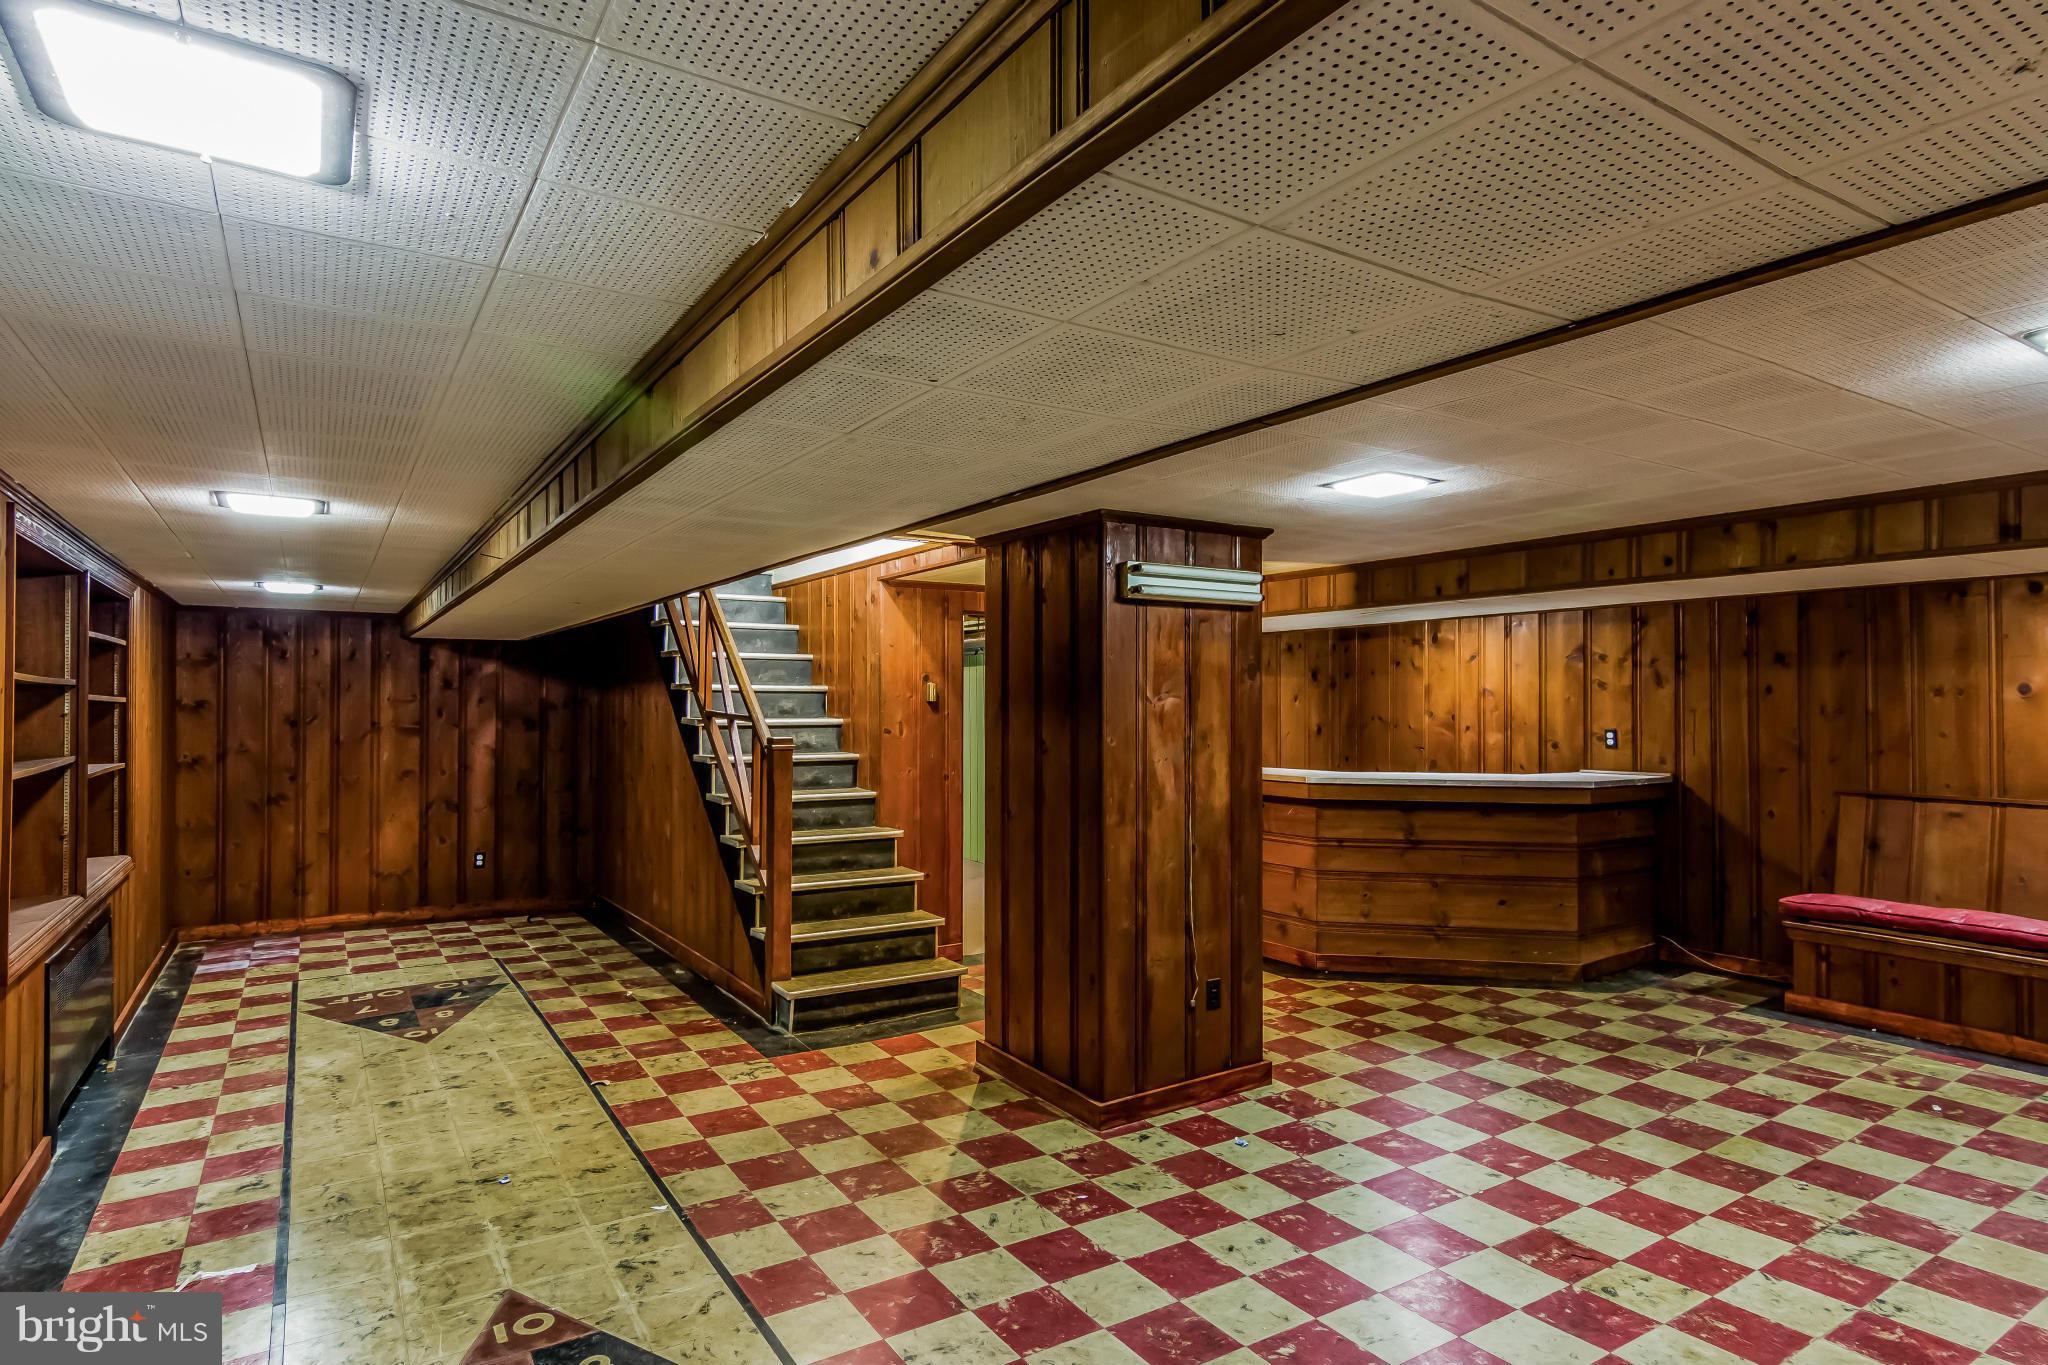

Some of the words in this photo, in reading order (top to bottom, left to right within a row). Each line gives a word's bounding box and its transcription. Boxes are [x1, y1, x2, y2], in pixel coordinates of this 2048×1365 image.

[433, 980, 469, 989] 10
[327, 989, 404, 1005] OFF
[447, 991, 470, 1001] 7
[355, 1005, 379, 1015] 7
[434, 1010, 455, 1018] 8
[378, 1018, 400, 1027] 8
[403, 1027, 439, 1038] 10
[492, 1312, 556, 1344] 10
